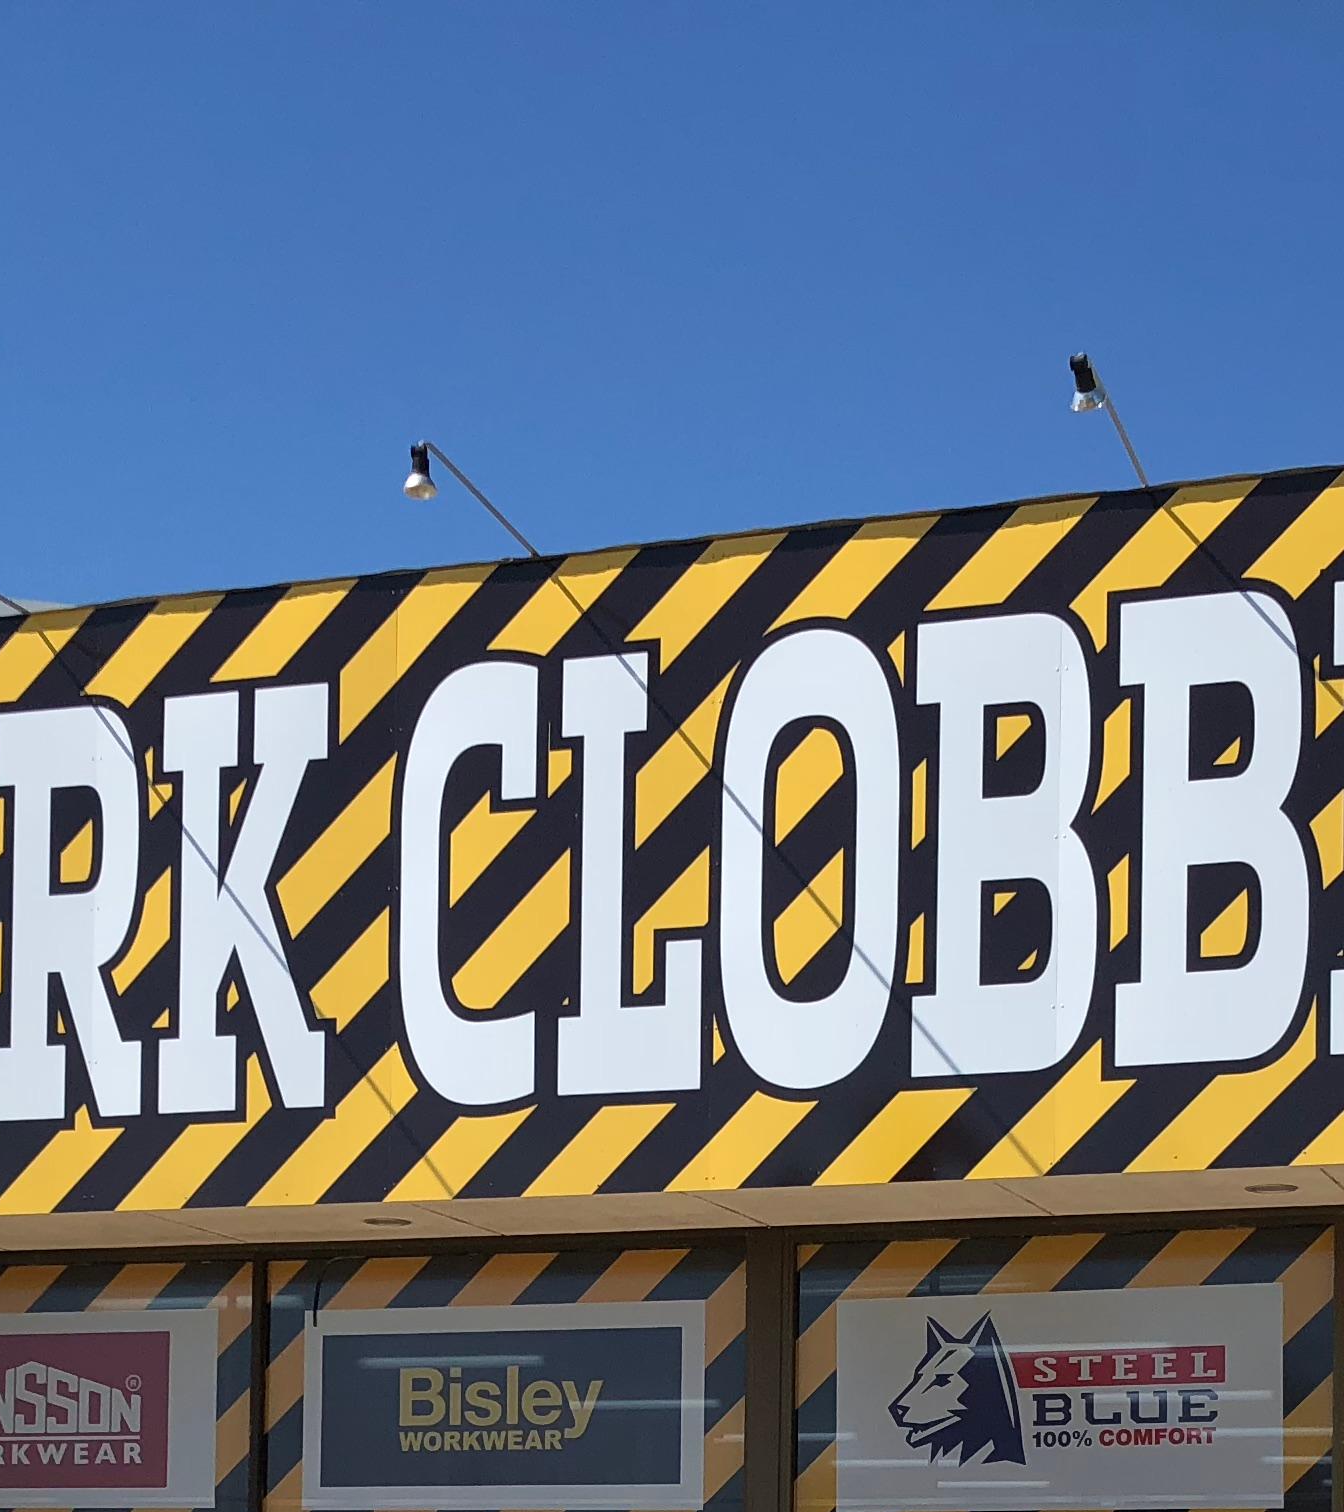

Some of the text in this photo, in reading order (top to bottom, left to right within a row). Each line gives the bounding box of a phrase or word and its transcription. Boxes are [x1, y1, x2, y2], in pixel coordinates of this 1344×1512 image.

[1033, 1351, 1218, 1382] STEEL
[398, 1365, 604, 1439] Bisley
[1032, 1389, 1219, 1426] BLUE
[399, 1430, 563, 1452] WORKWEAR
[1032, 1427, 1217, 1448] 100% COMFORT
